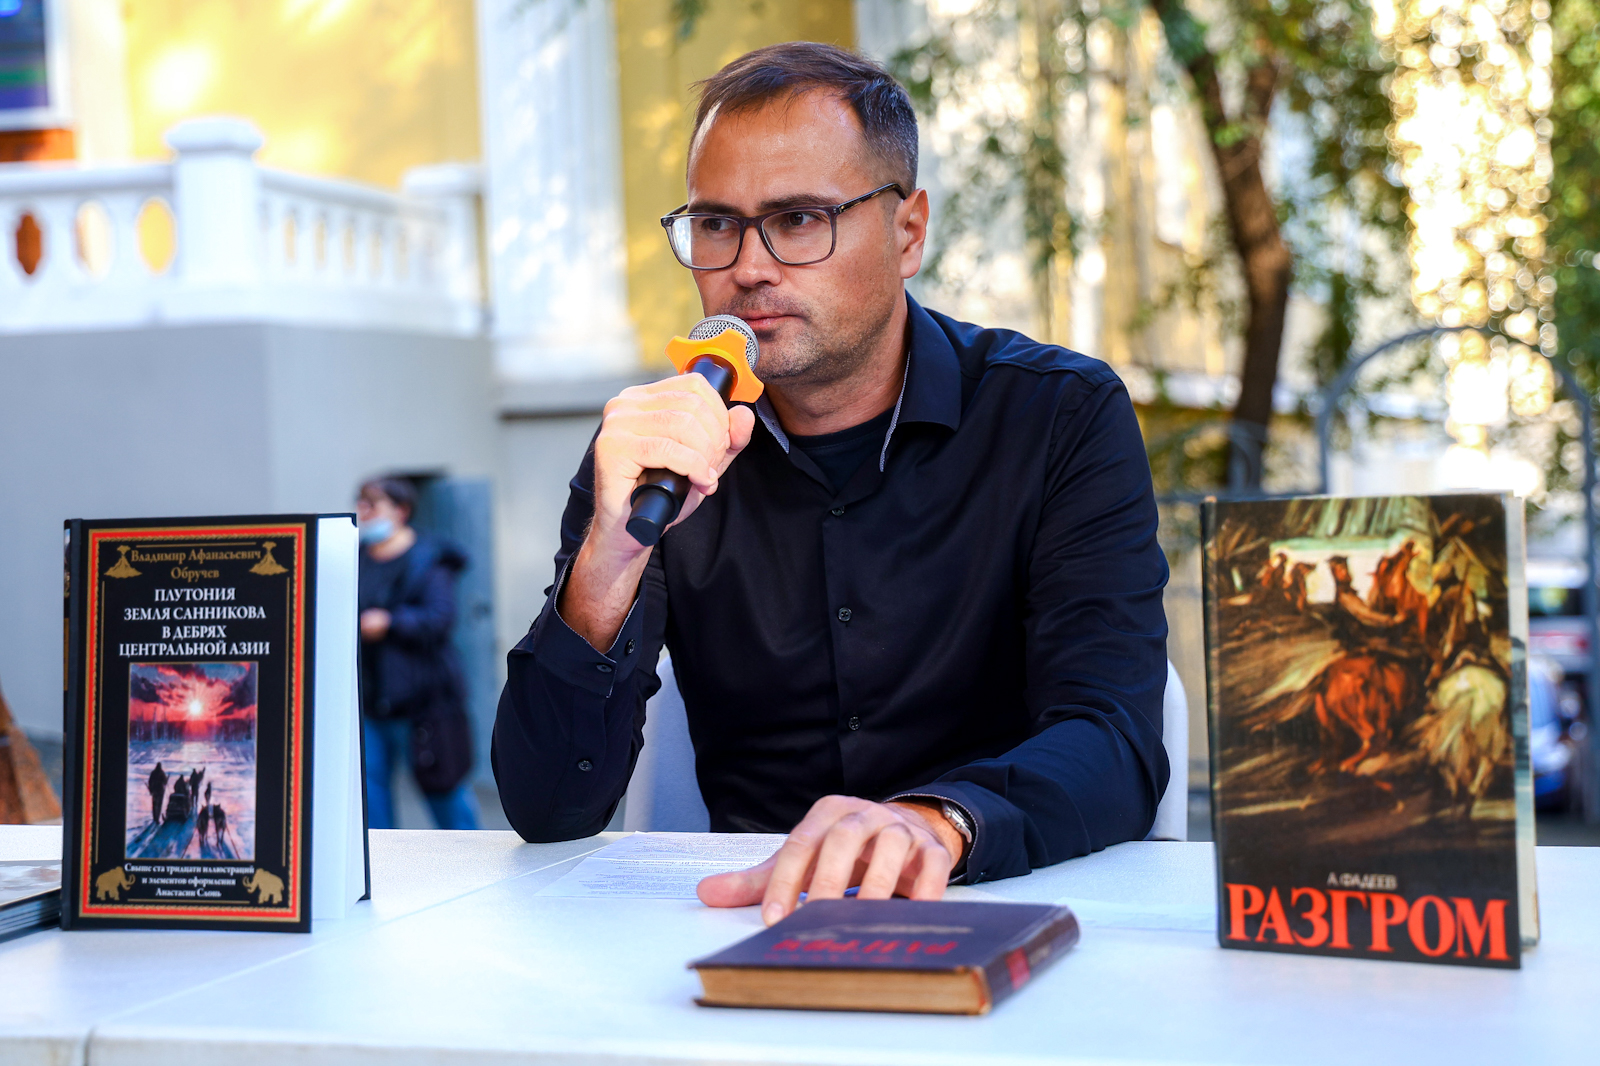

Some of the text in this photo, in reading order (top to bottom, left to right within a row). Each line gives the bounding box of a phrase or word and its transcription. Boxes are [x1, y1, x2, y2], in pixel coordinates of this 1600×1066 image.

[131, 548, 261, 564] Владимир Афанасьевич
[171, 566, 219, 582] Обручев
[154, 587, 236, 602] ПЛУТОНИЯ
[124, 605, 266, 621] ЗЕМЛЯ САННИКОВА
[162, 625, 227, 640] В ДЕБРЯХ
[119, 640, 270, 658] ЦЕНТРАЛЬНОЙ АЗИИ
[124, 863, 152, 872] Свыше
[188, 876, 236, 887] оформления
[1225, 882, 1511, 961] РАЗГРОМ
